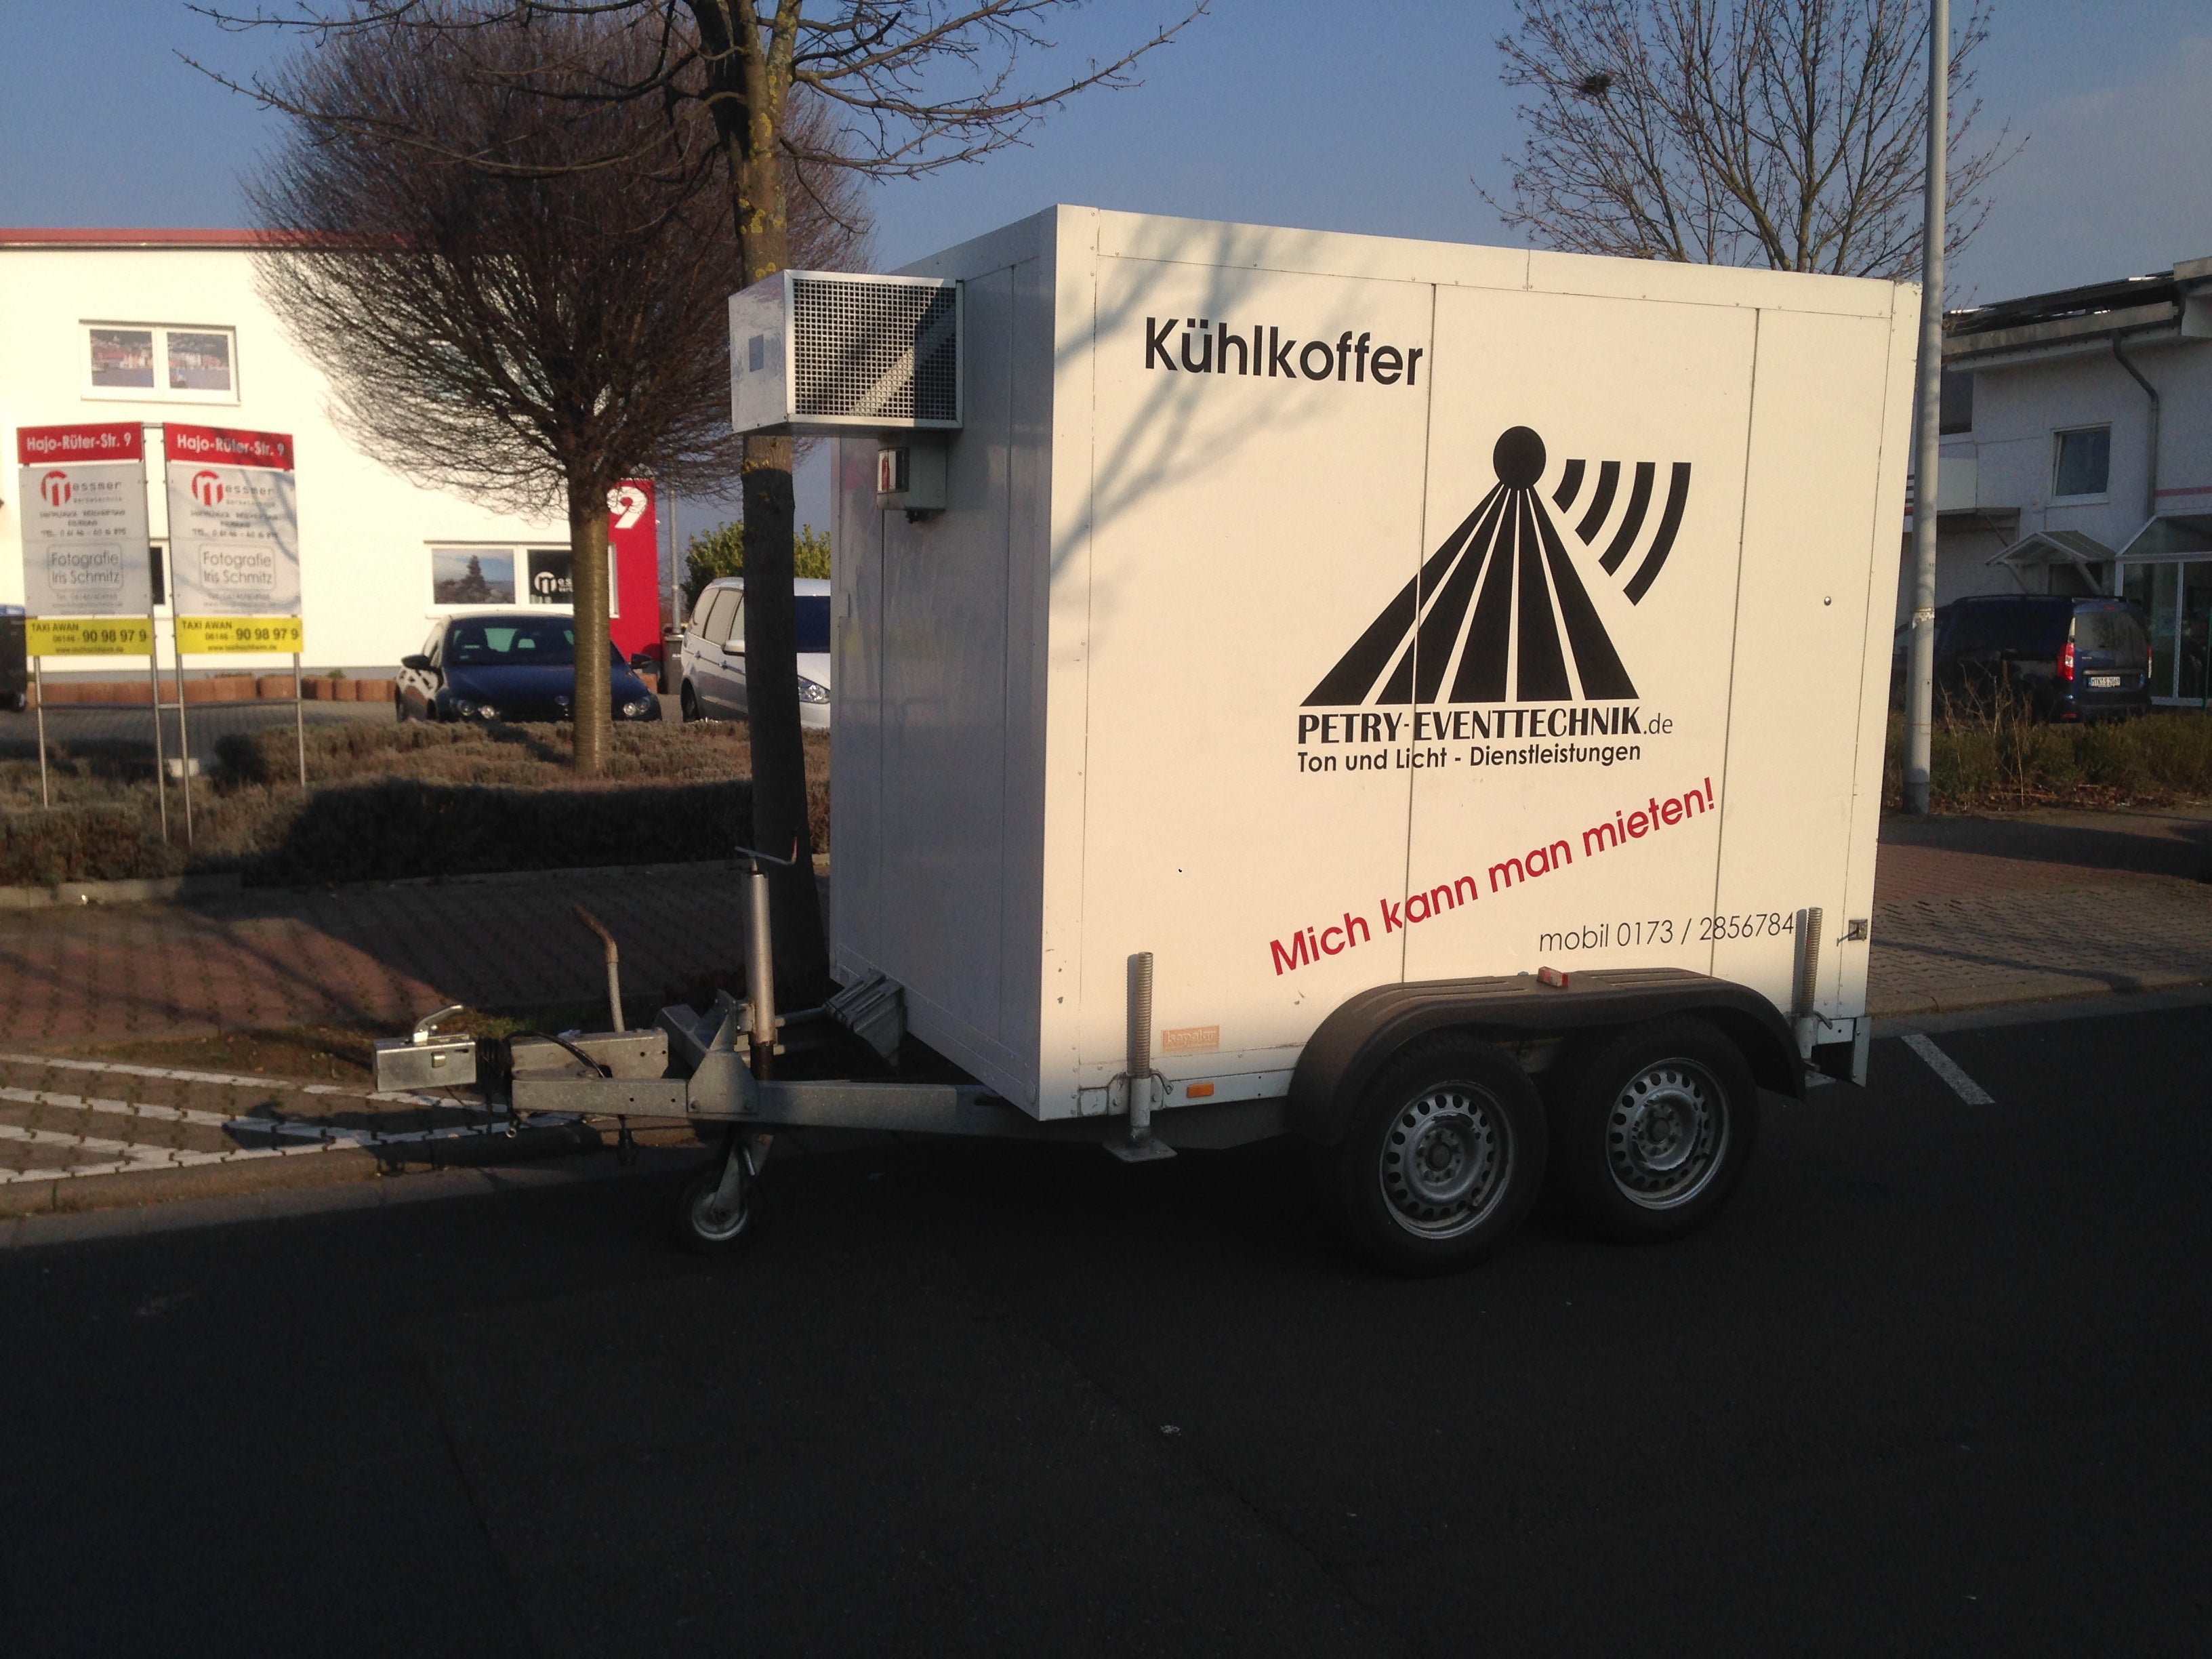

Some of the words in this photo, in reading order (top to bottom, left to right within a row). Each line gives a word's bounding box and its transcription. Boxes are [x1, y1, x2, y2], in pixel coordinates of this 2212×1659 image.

[1145, 316, 1423, 386] Kühlkoffer
[26, 433, 120, 454] Hajo-Rüter-Str.
[123, 432, 131, 447] 9
[177, 434, 274, 457] Hajo-Rüter-Str.
[276, 443, 285, 457] 9
[607, 486, 649, 529] 9
[51, 550, 119, 569] Fotografie
[203, 551, 271, 569] Fotografie
[52, 573, 67, 584] Iris
[70, 571, 120, 585] Schmitz
[204, 571, 220, 583] Iris
[223, 569, 272, 584] Schmitz
[32, 623, 50, 632] TAXI
[52, 623, 79, 632] AWAN
[82, 630, 98, 642] 90
[101, 630, 117, 642] 98
[120, 629, 135, 642] 97
[139, 629, 147, 642] 9
[182, 621, 202, 630] TAXI
[205, 621, 232, 630] AWAN
[235, 628, 251, 640] 90
[255, 628, 270, 640] 98
[273, 628, 287, 640] 97
[291, 628, 299, 640] 9
[1298, 706, 1673, 744] PETRY-EVENTTECHNIK.de
[1298, 750, 1338, 773] Ton
[1345, 749, 1387, 771] und
[1396, 746, 1447, 769] Licht
[1470, 742, 1641, 766] Dienstleistungen
[1269, 912, 1371, 976] Mich
[1379, 874, 1479, 933] kann
[1488, 839, 1573, 893] man
[1582, 777, 1715, 857] mieten!
[1539, 923, 1609, 951] mobil
[1617, 919, 1674, 947] 0173
[1681, 918, 1692, 945] /
[1699, 912, 1795, 941] 2856784
